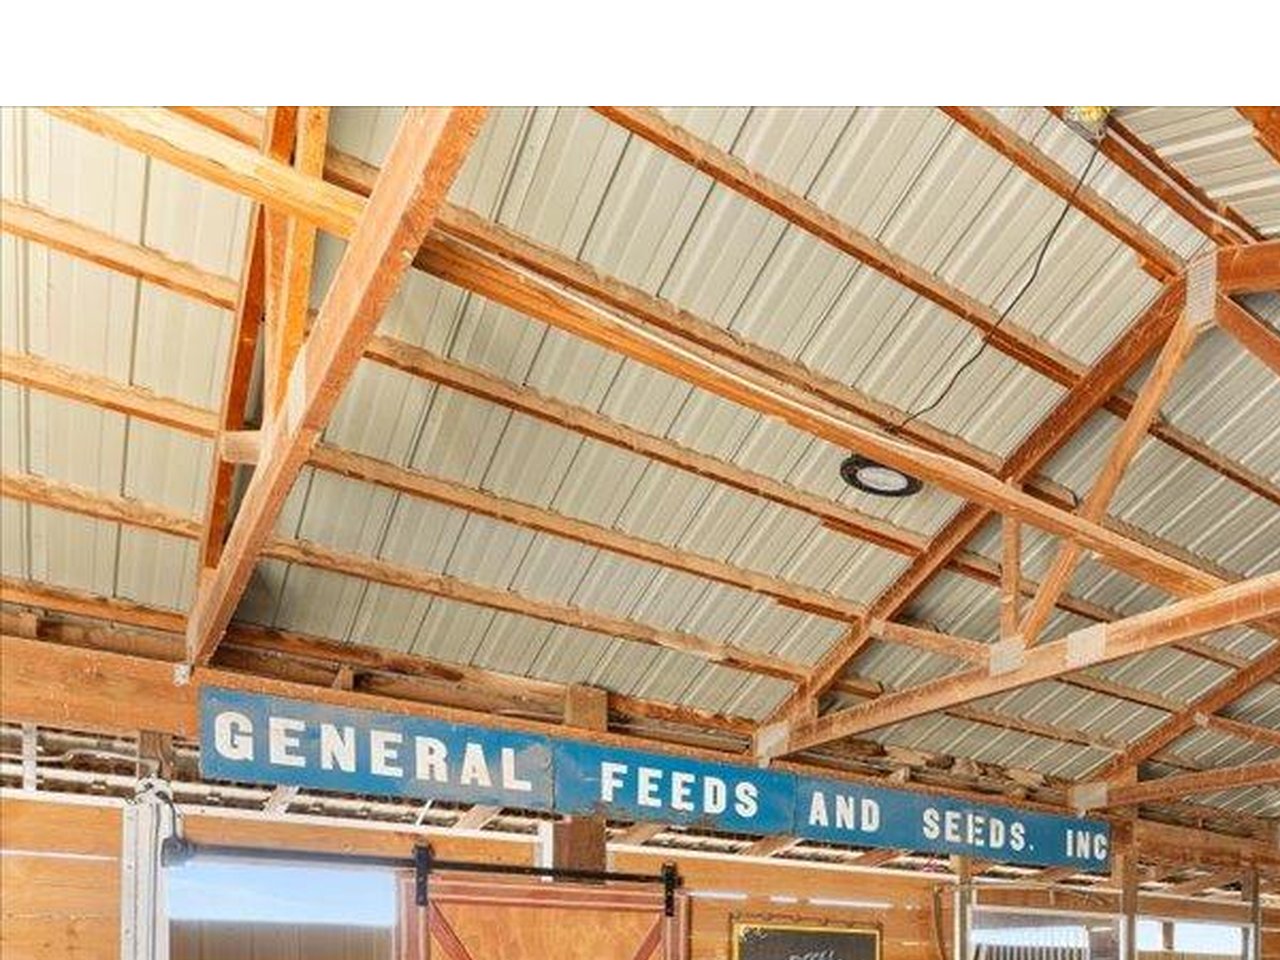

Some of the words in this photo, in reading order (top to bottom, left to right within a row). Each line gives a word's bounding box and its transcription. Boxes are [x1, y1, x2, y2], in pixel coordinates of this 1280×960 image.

[213, 710, 533, 792] GENERAL
[600, 761, 759, 818] FEEDS
[808, 791, 882, 832] AND
[1066, 829, 1108, 861] INC
